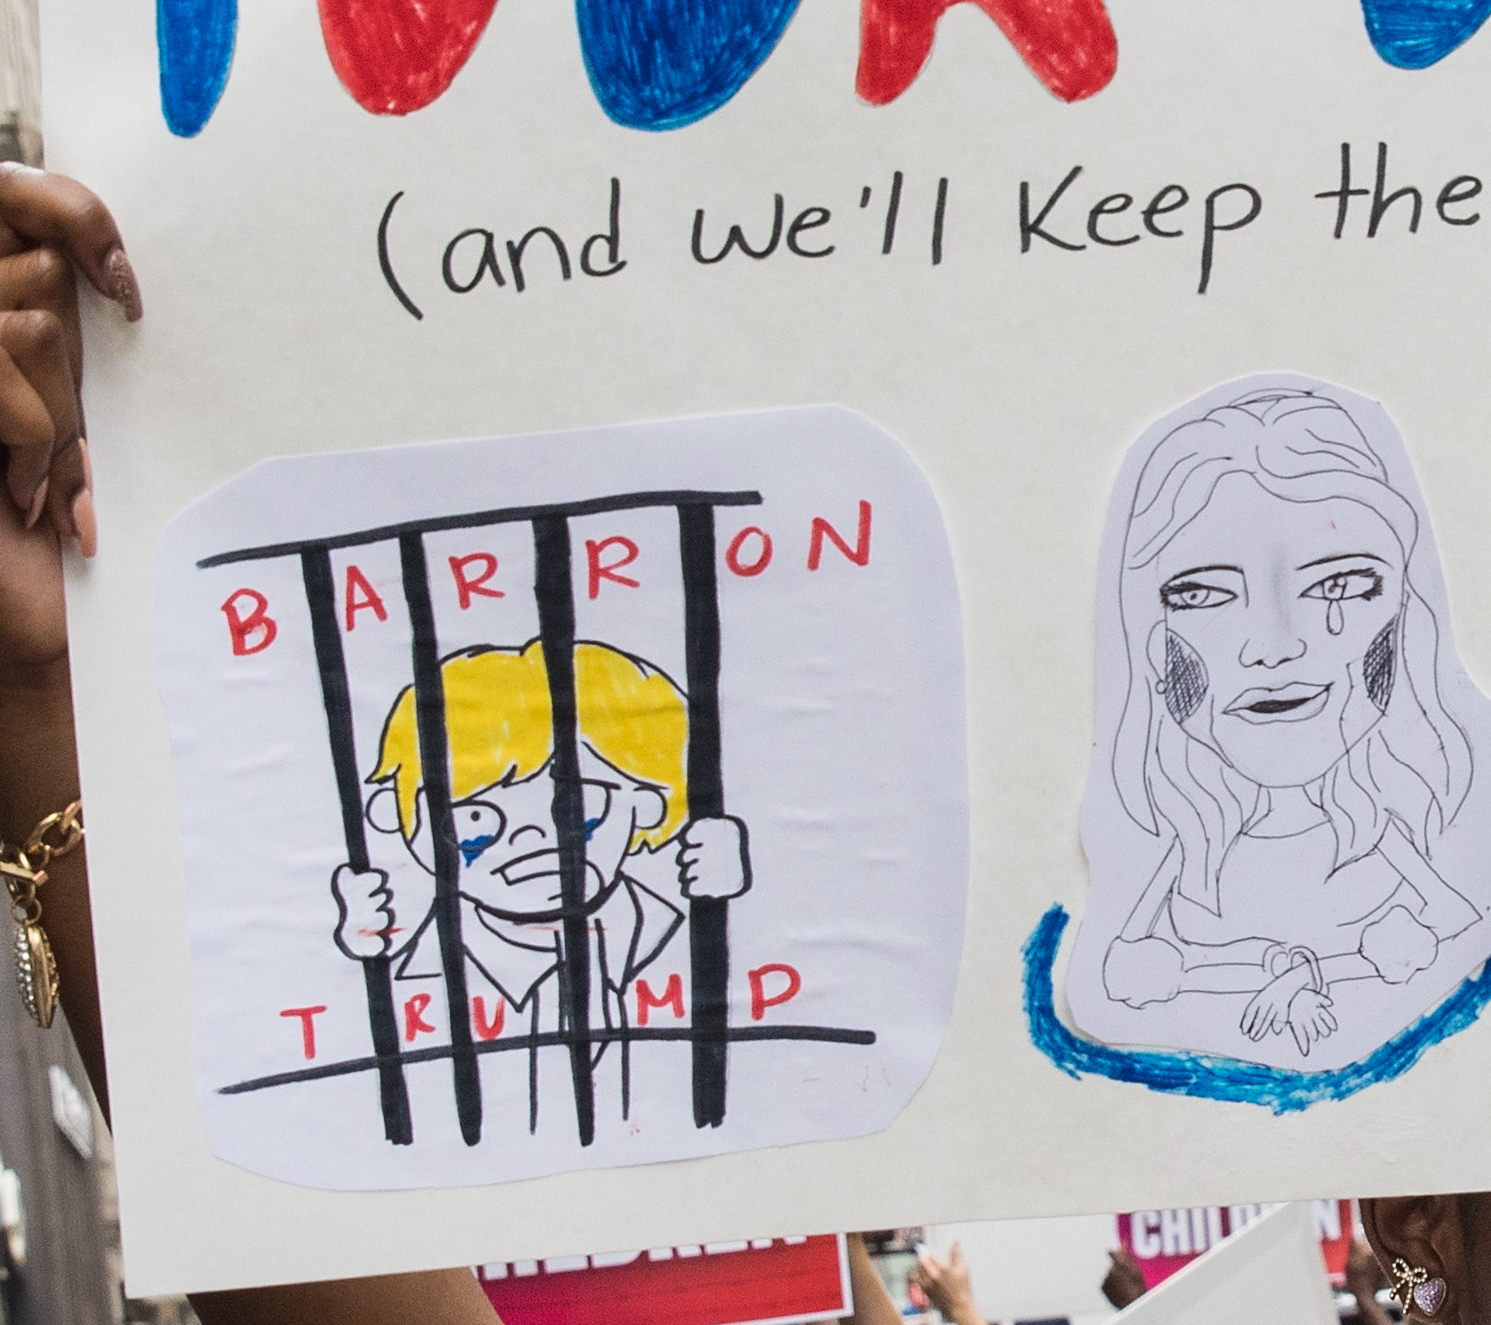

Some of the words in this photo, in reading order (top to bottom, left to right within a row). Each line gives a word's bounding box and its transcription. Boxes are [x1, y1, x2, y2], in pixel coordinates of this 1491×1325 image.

[377, 177, 627, 320] (and
[690, 170, 949, 265] we'll
[1316, 142, 1483, 240] the
[221, 500, 872, 657] BARRON
[280, 963, 802, 1060] TRUMP
